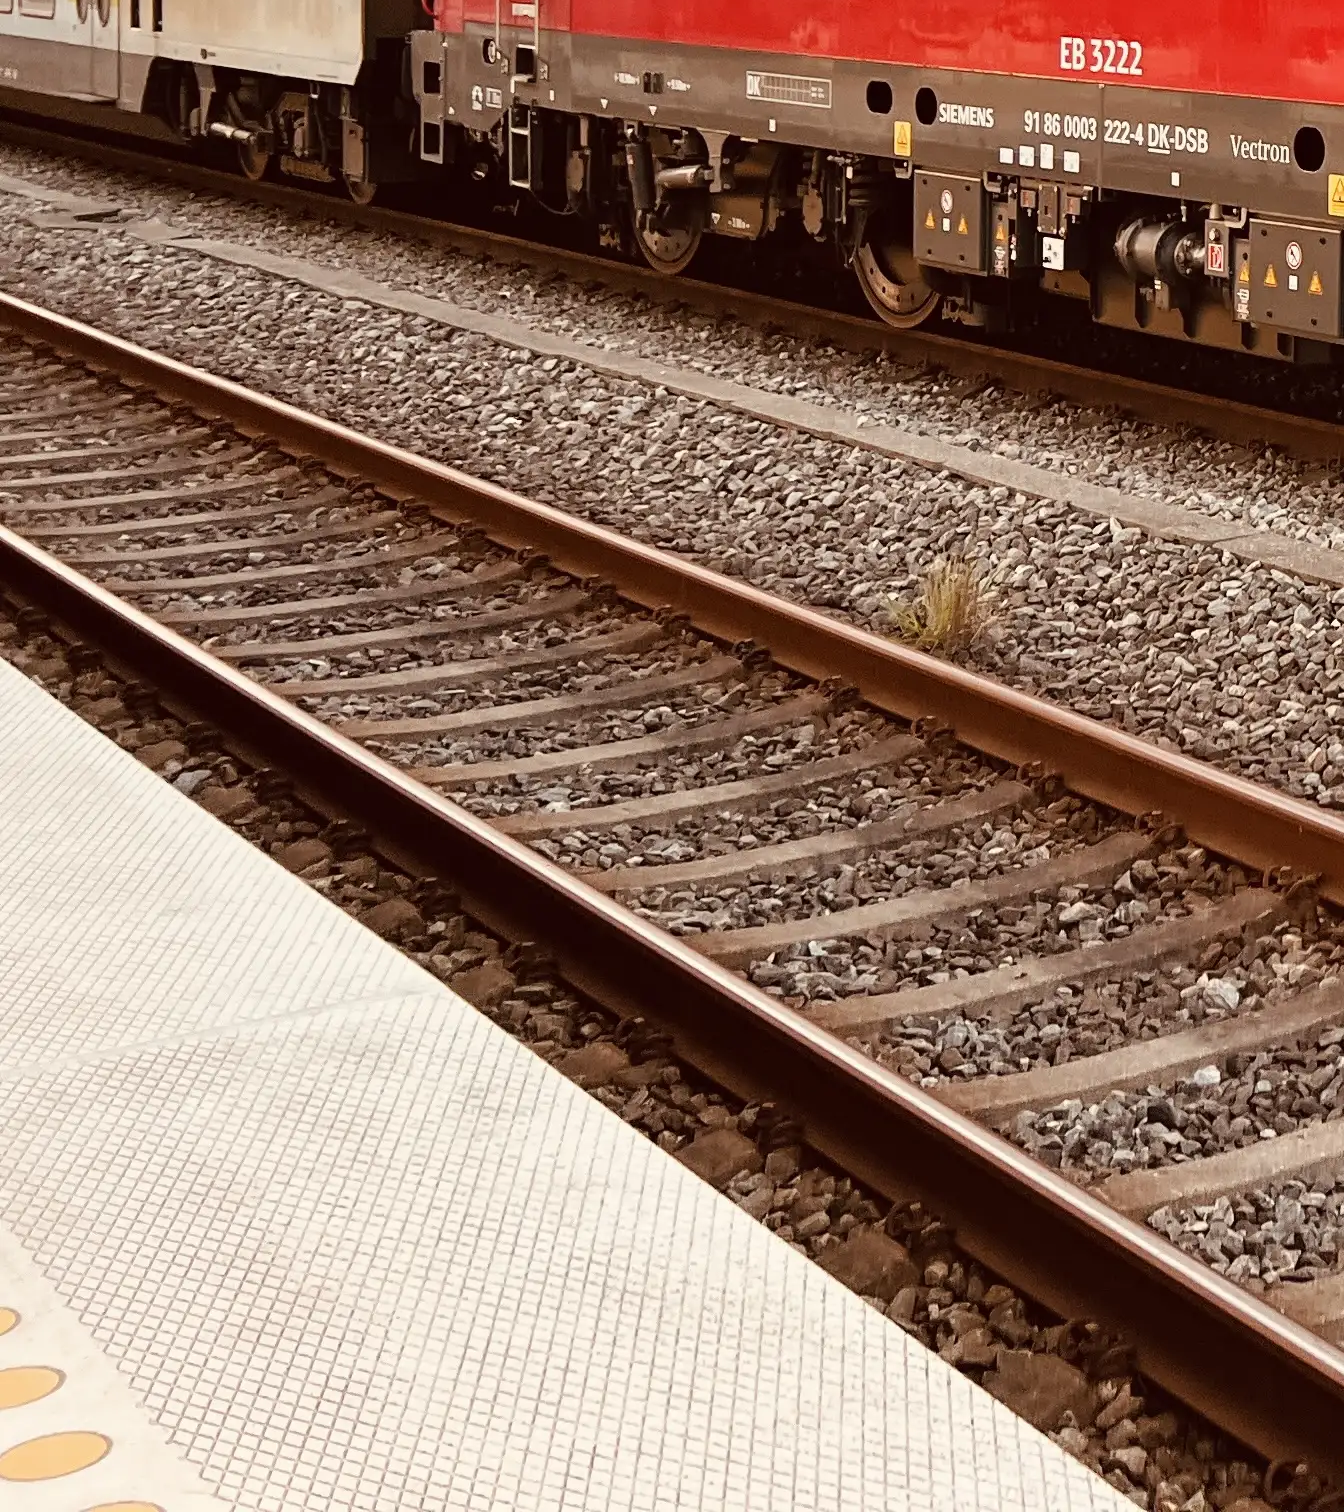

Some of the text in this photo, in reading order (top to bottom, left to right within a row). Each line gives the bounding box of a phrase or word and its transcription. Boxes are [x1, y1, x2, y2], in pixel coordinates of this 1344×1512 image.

[1060, 36, 1143, 75] EB 3222
[939, 103, 995, 128] SIEMENS
[1024, 109, 1209, 155] 91 86 0003 222-4 DK-DSB
[1229, 134, 1291, 164] Vectron
